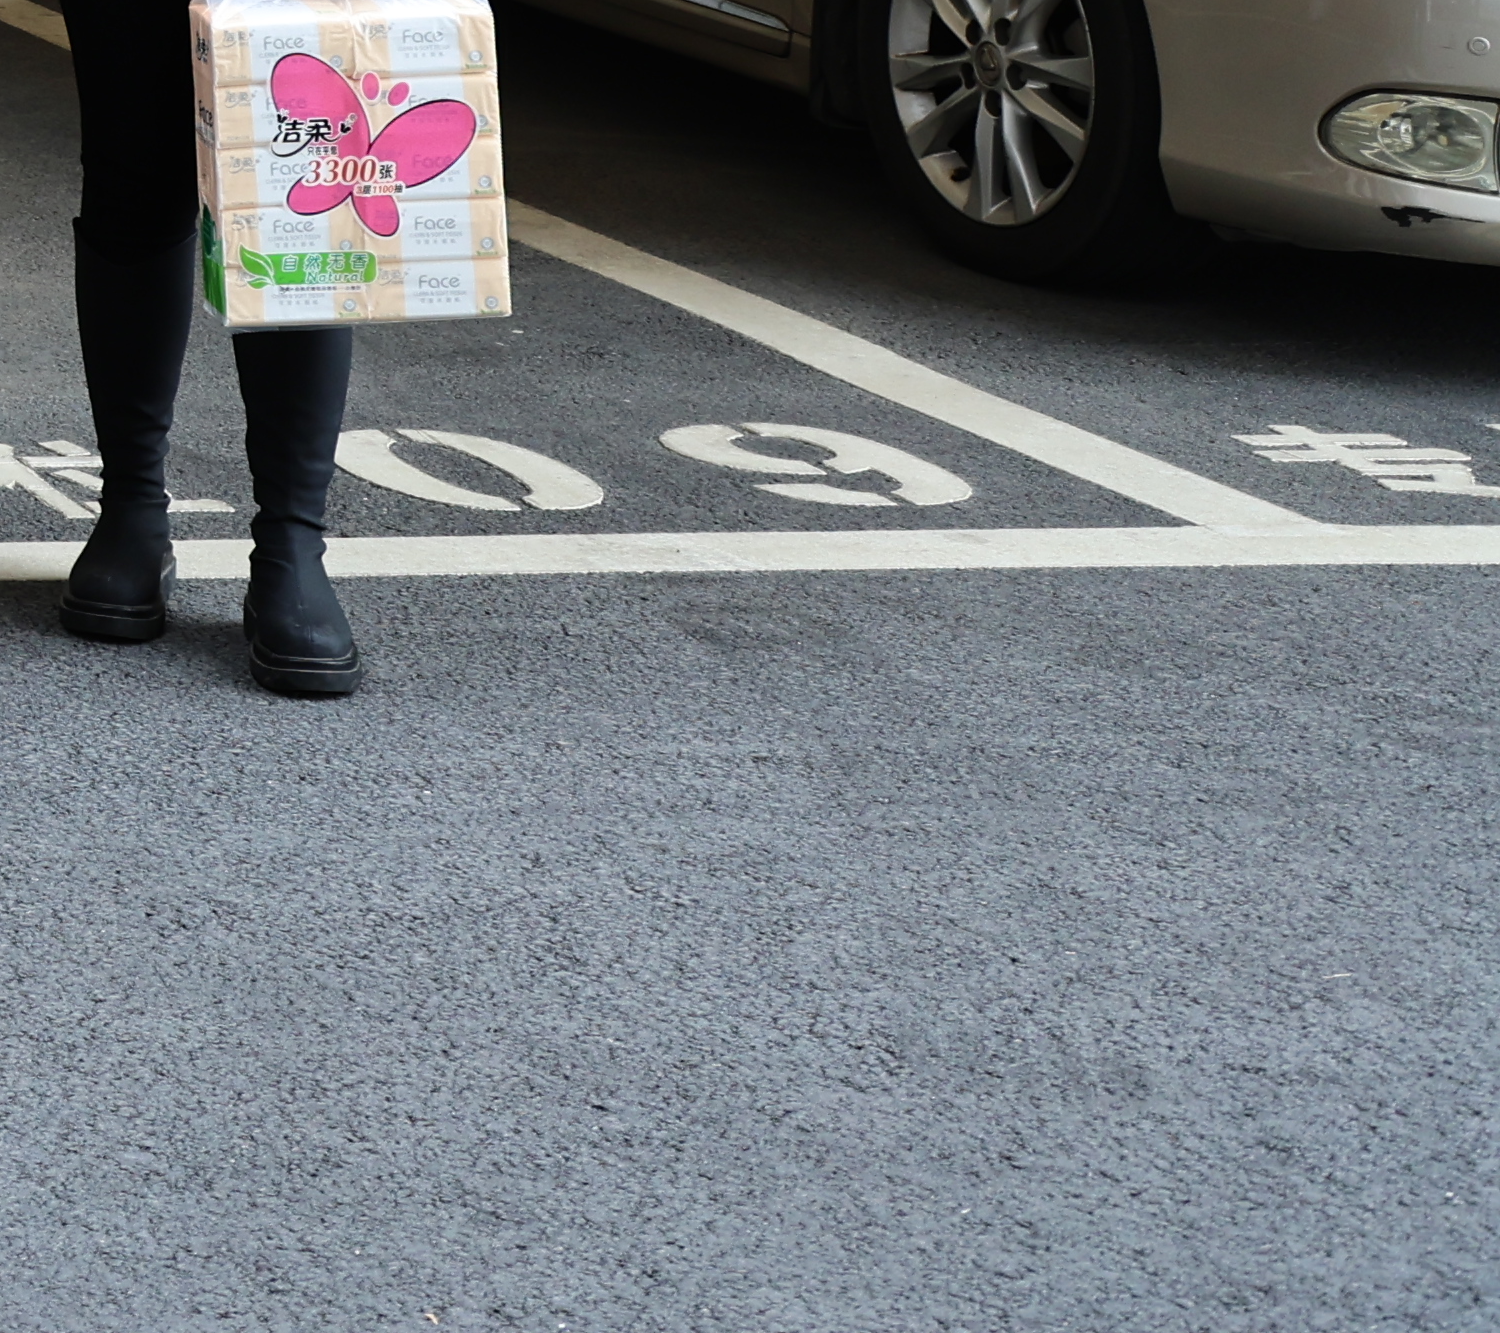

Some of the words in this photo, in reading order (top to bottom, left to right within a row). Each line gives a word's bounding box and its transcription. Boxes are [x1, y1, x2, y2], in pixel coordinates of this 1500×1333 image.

[263, 35, 304, 50] Face
[402, 28, 444, 43] Face
[305, 158, 394, 185] 3300张
[273, 219, 315, 234] Face
[414, 215, 456, 230] Face
[282, 253, 369, 272] 自然无香
[305, 270, 365, 284] Natural
[418, 275, 460, 290] Face
